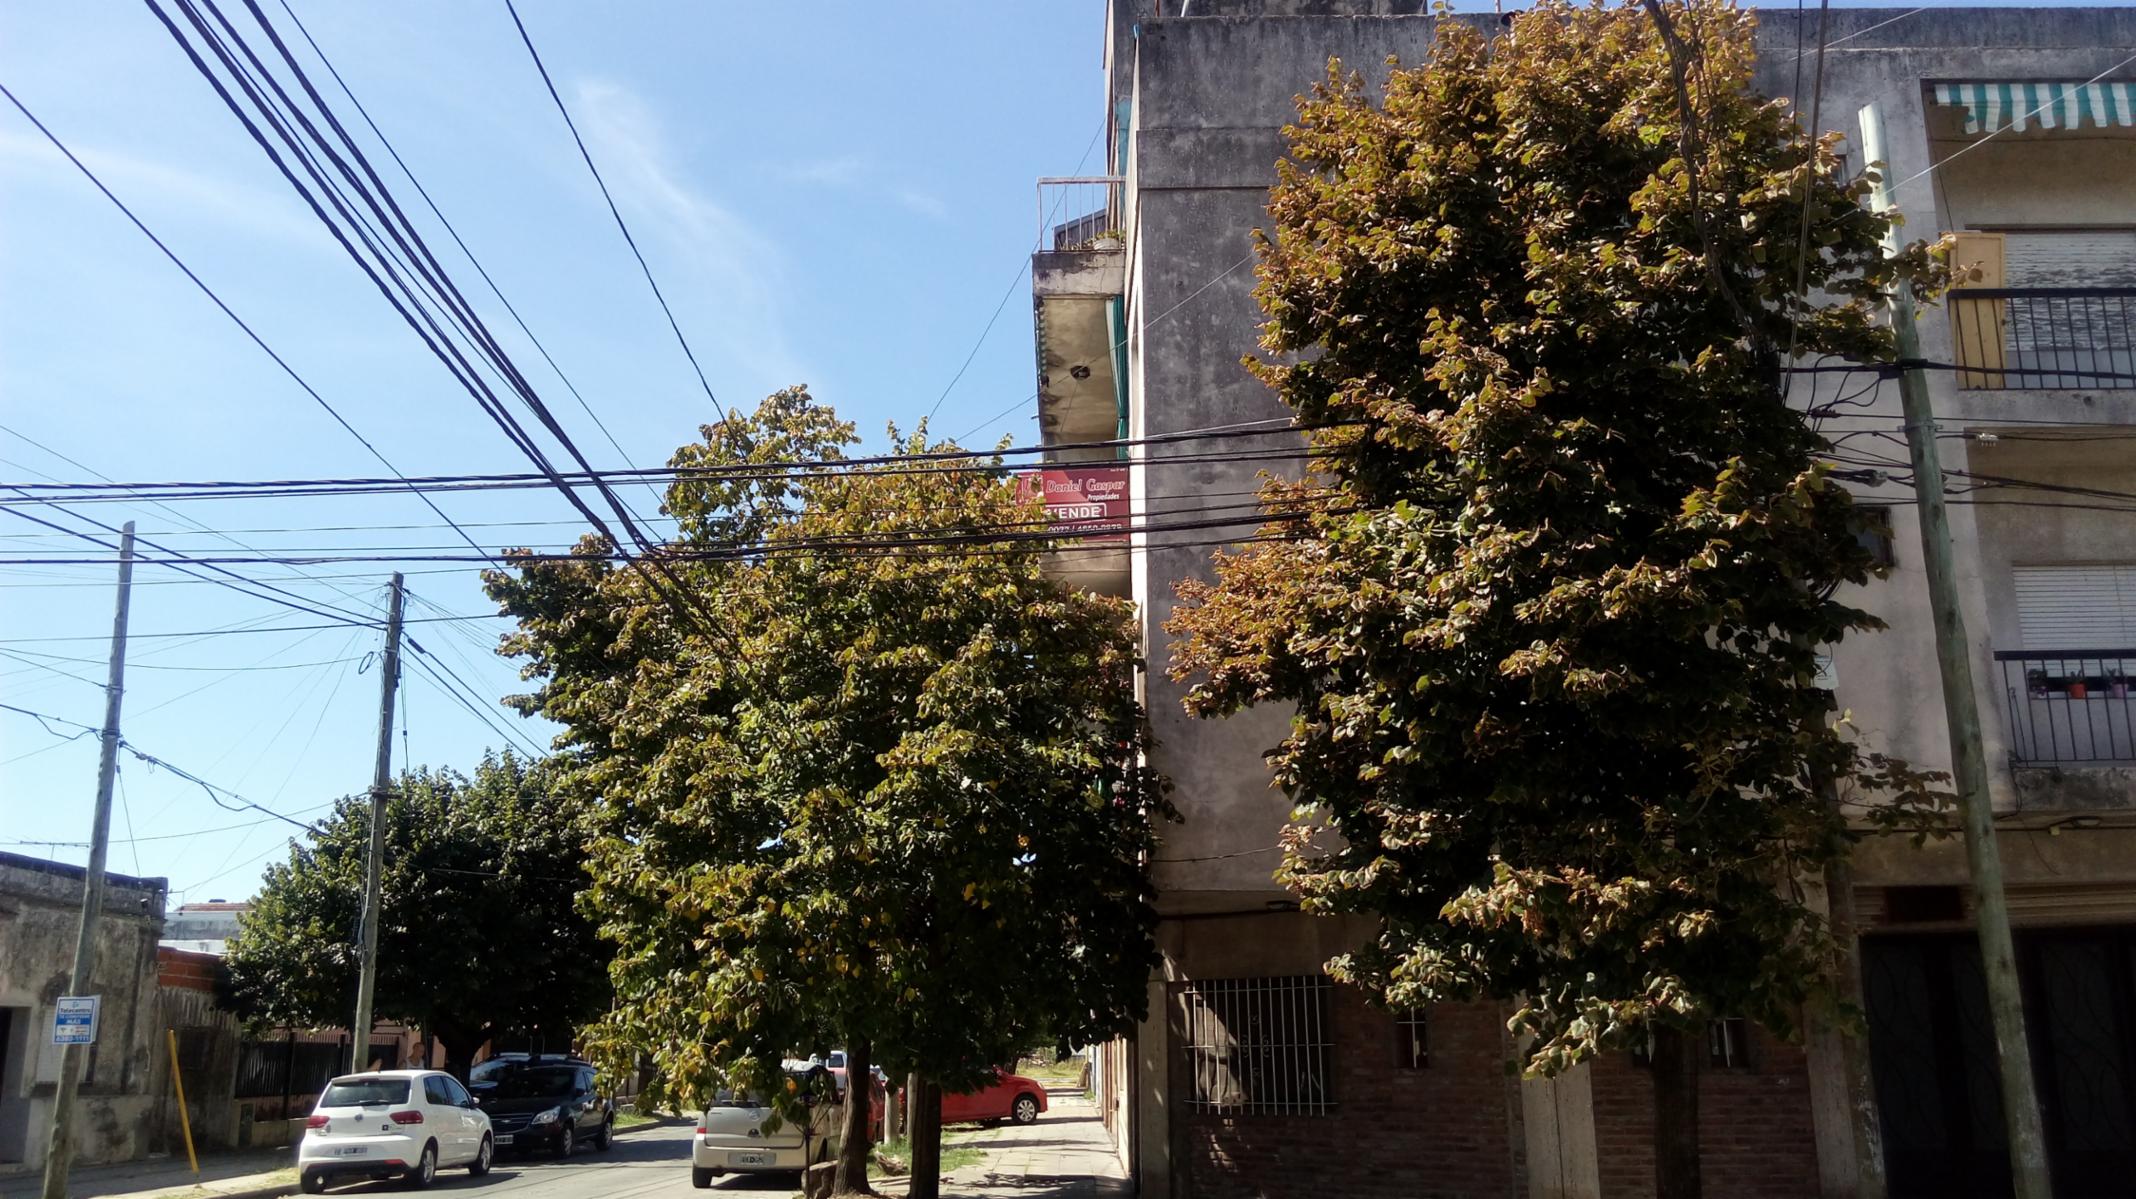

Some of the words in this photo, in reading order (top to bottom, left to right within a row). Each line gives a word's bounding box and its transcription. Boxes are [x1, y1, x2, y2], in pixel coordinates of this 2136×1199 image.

[1045, 479, 1083, 493] Daniel
[1086, 478, 1126, 492] Gaspar
[1087, 493, 1120, 501] Propiedades
